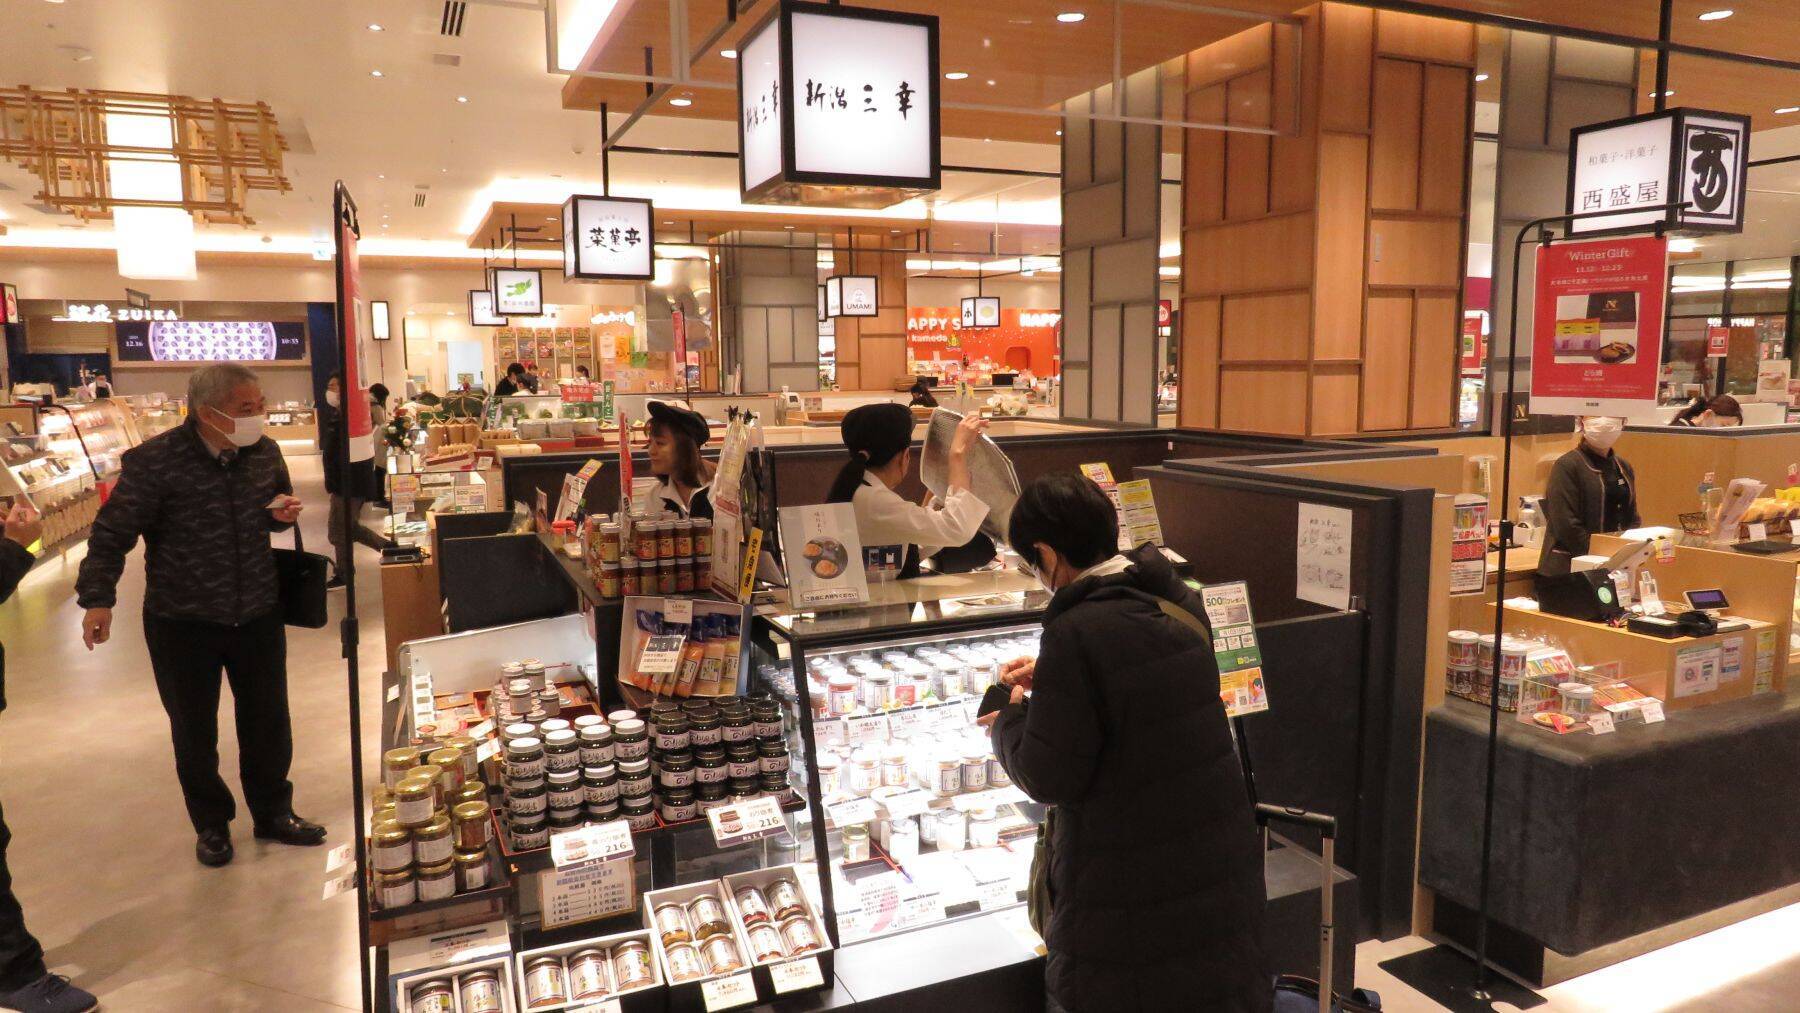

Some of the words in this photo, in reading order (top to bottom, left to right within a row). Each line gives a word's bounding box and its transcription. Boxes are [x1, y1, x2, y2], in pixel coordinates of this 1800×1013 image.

[1588, 146, 1658, 166] 和菓子・洋菓子
[1582, 180, 1659, 211] 西盛屋
[1569, 250, 1607, 261] Winter
[1607, 248, 1631, 259] Gift
[117, 308, 178, 321] ZUIKA
[759, 816, 779, 828] 216
[605, 841, 628, 853] 216
